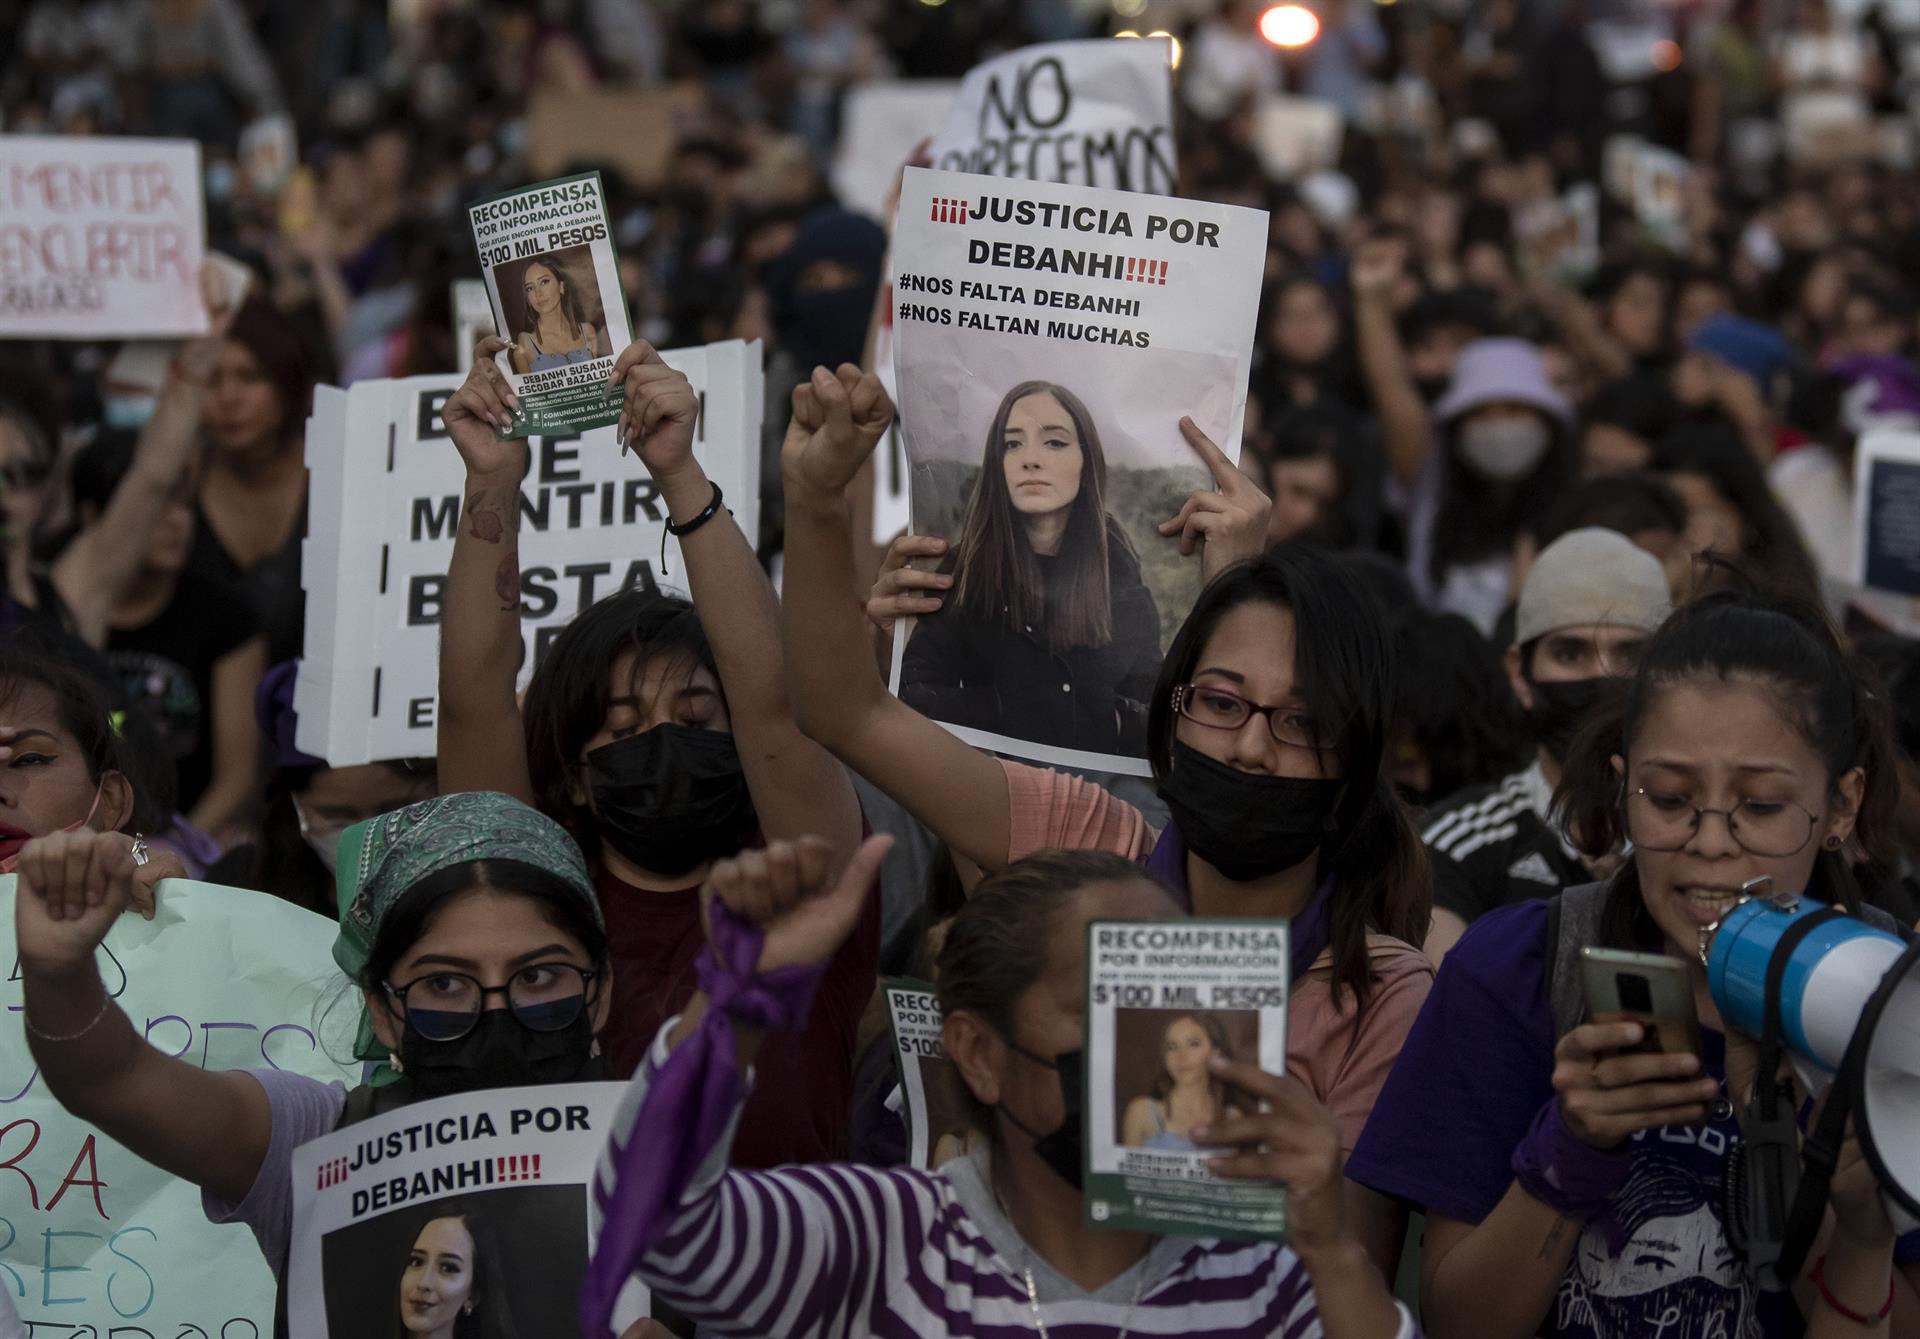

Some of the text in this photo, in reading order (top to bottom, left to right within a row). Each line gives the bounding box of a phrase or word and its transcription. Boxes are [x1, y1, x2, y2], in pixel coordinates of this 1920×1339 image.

[978, 56, 1073, 138] NO
[473, 182, 598, 225] RECOMPENSA
[477, 199, 597, 238] POR INFORMACIÓN
[479, 241, 490, 249] QUE
[491, 235, 510, 245] AYUDE
[511, 224, 555, 240] ENCONTRAR
[564, 214, 602, 228] DEBANHI
[515, 237, 545, 258] MIL
[548, 223, 607, 250] PESOS
[1145, 214, 1219, 248] POR
[968, 239, 1168, 286] DEBANHI!!!!
[899, 273, 1140, 317] #NOS FALTA DEBANHI
[899, 302, 1150, 349] #NOS FALTAN MUCHAS
[518, 381, 564, 395] ESCOBAR
[522, 359, 614, 385] DEBANHI SUSANA
[523, 432, 581, 483] E
[410, 478, 663, 542] MNTIR
[407, 559, 660, 627] BSTA
[1098, 931, 1281, 950] RECOMPENSA
[1101, 953, 1138, 967] POR
[1094, 985, 1282, 1007] $100 MIL PESOS
[898, 1012, 927, 1024] POR
[510, 1105, 591, 1135] POR
[352, 1154, 541, 1218] DEBANHI!!!!
